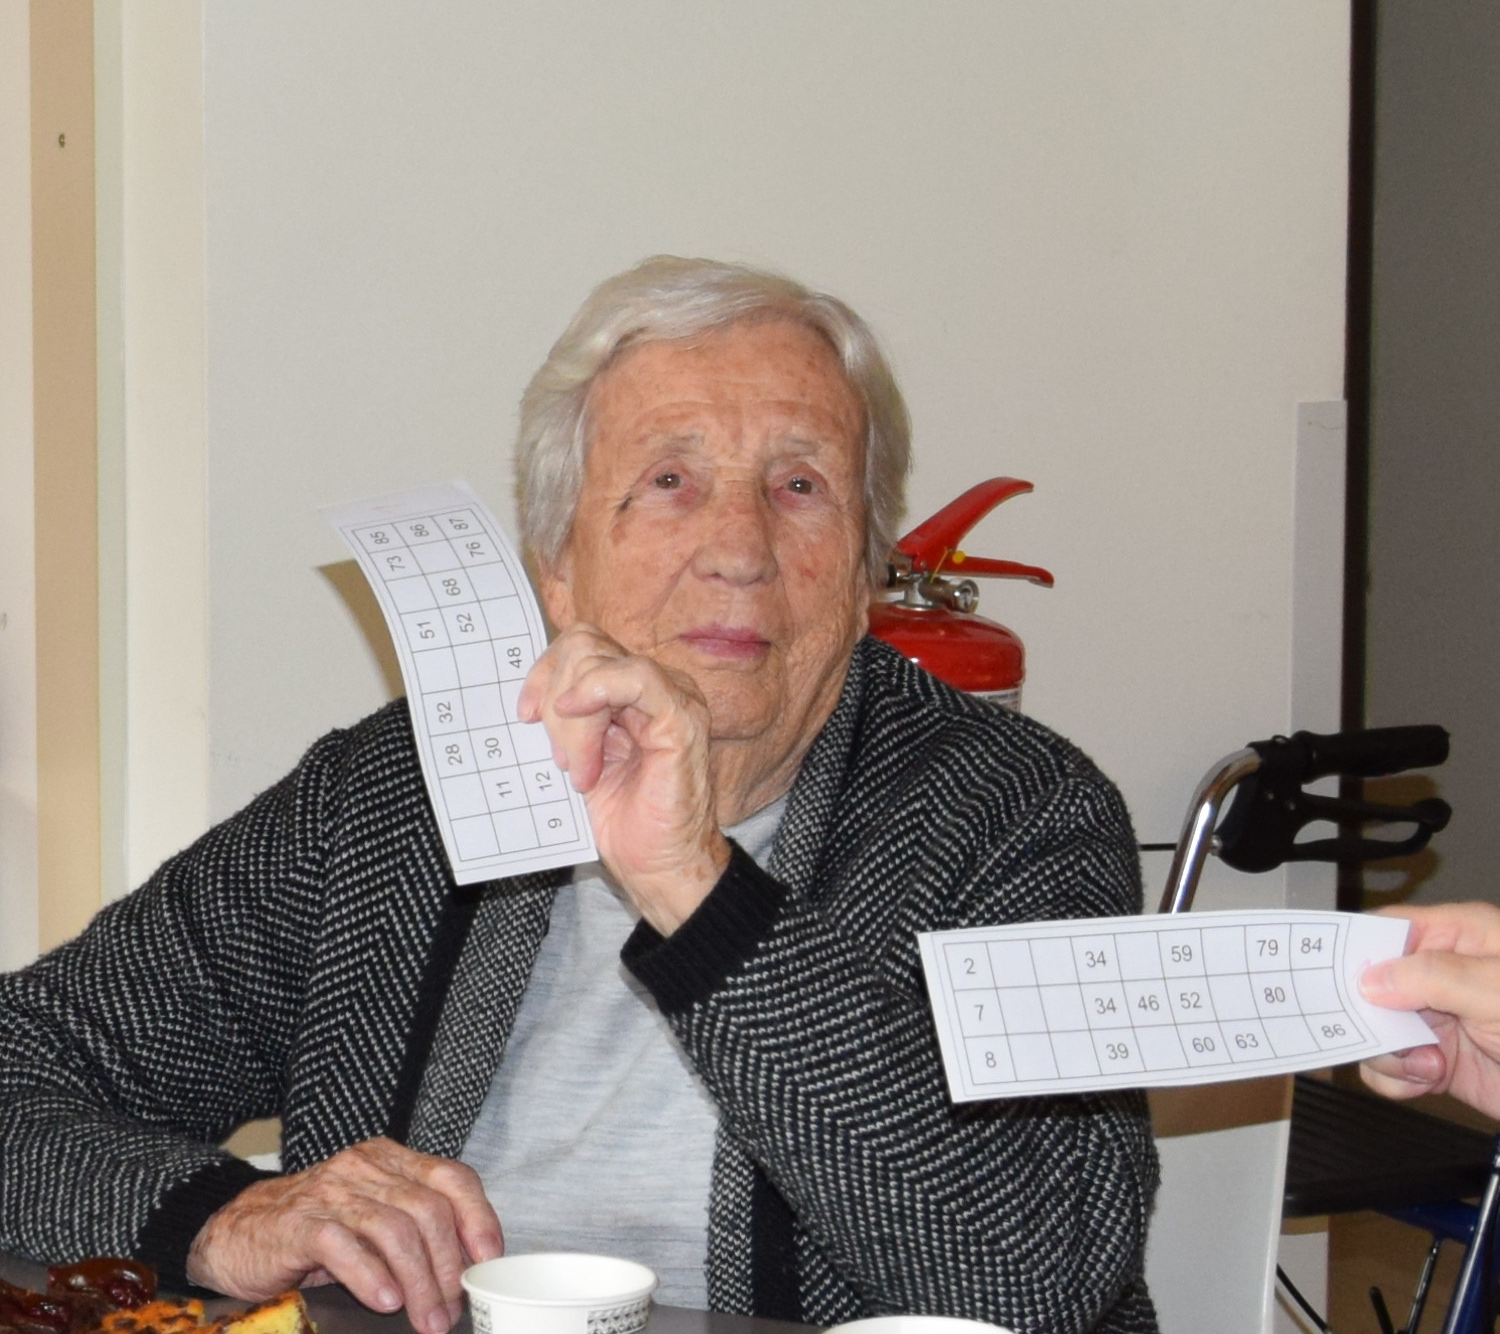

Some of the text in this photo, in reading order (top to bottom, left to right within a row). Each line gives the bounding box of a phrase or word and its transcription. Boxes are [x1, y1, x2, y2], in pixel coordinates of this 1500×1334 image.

[371, 531, 463, 766] 28 32 51 73 85
[411, 523, 513, 798] 11 30 52 68 86
[448, 518, 563, 829] 9 12 48 76 87
[963, 937, 1323, 975] 2 34 59 79 84
[974, 986, 1286, 1021] 7 34 46 52 80
[984, 1023, 1347, 1069] 8 39 60 63 86
